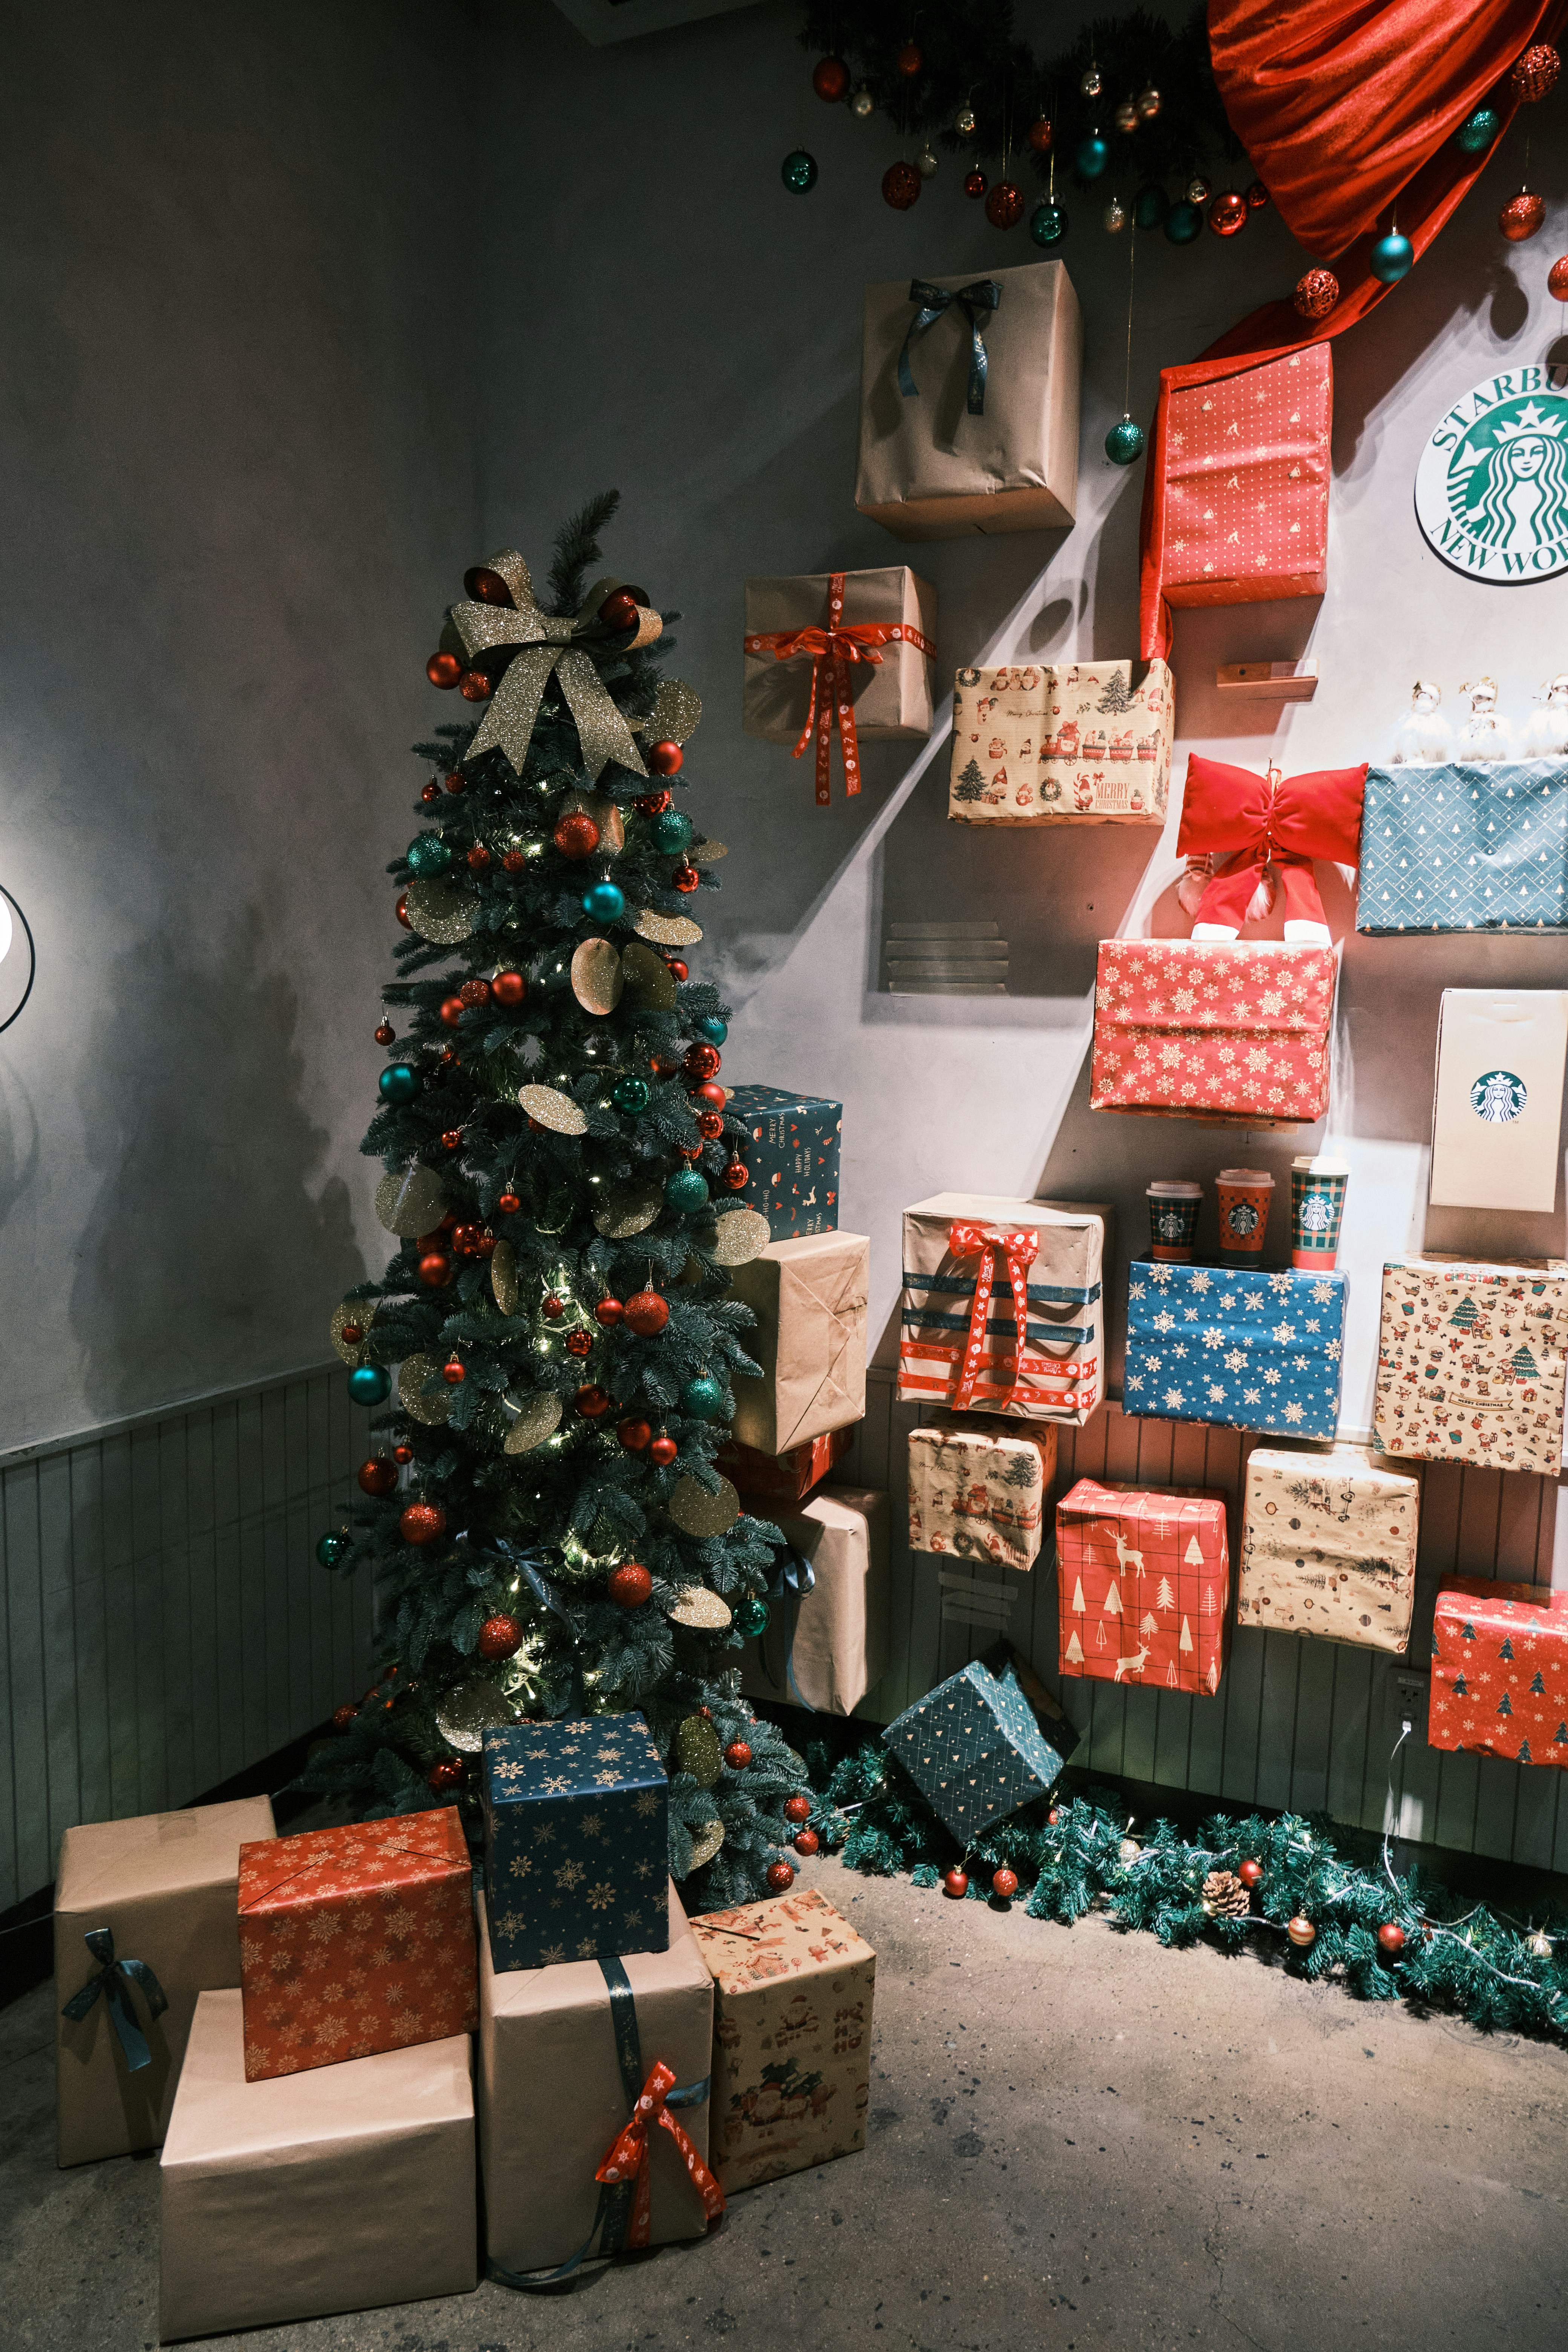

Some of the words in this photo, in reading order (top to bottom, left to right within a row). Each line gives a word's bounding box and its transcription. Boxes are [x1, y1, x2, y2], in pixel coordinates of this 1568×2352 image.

[1430, 518, 1498, 571] NEW
[1096, 783, 1130, 799] MERRY
[1095, 799, 1128, 809] CHRISTMAS
[1444, 1272, 1508, 1287] CHRISTMAS
